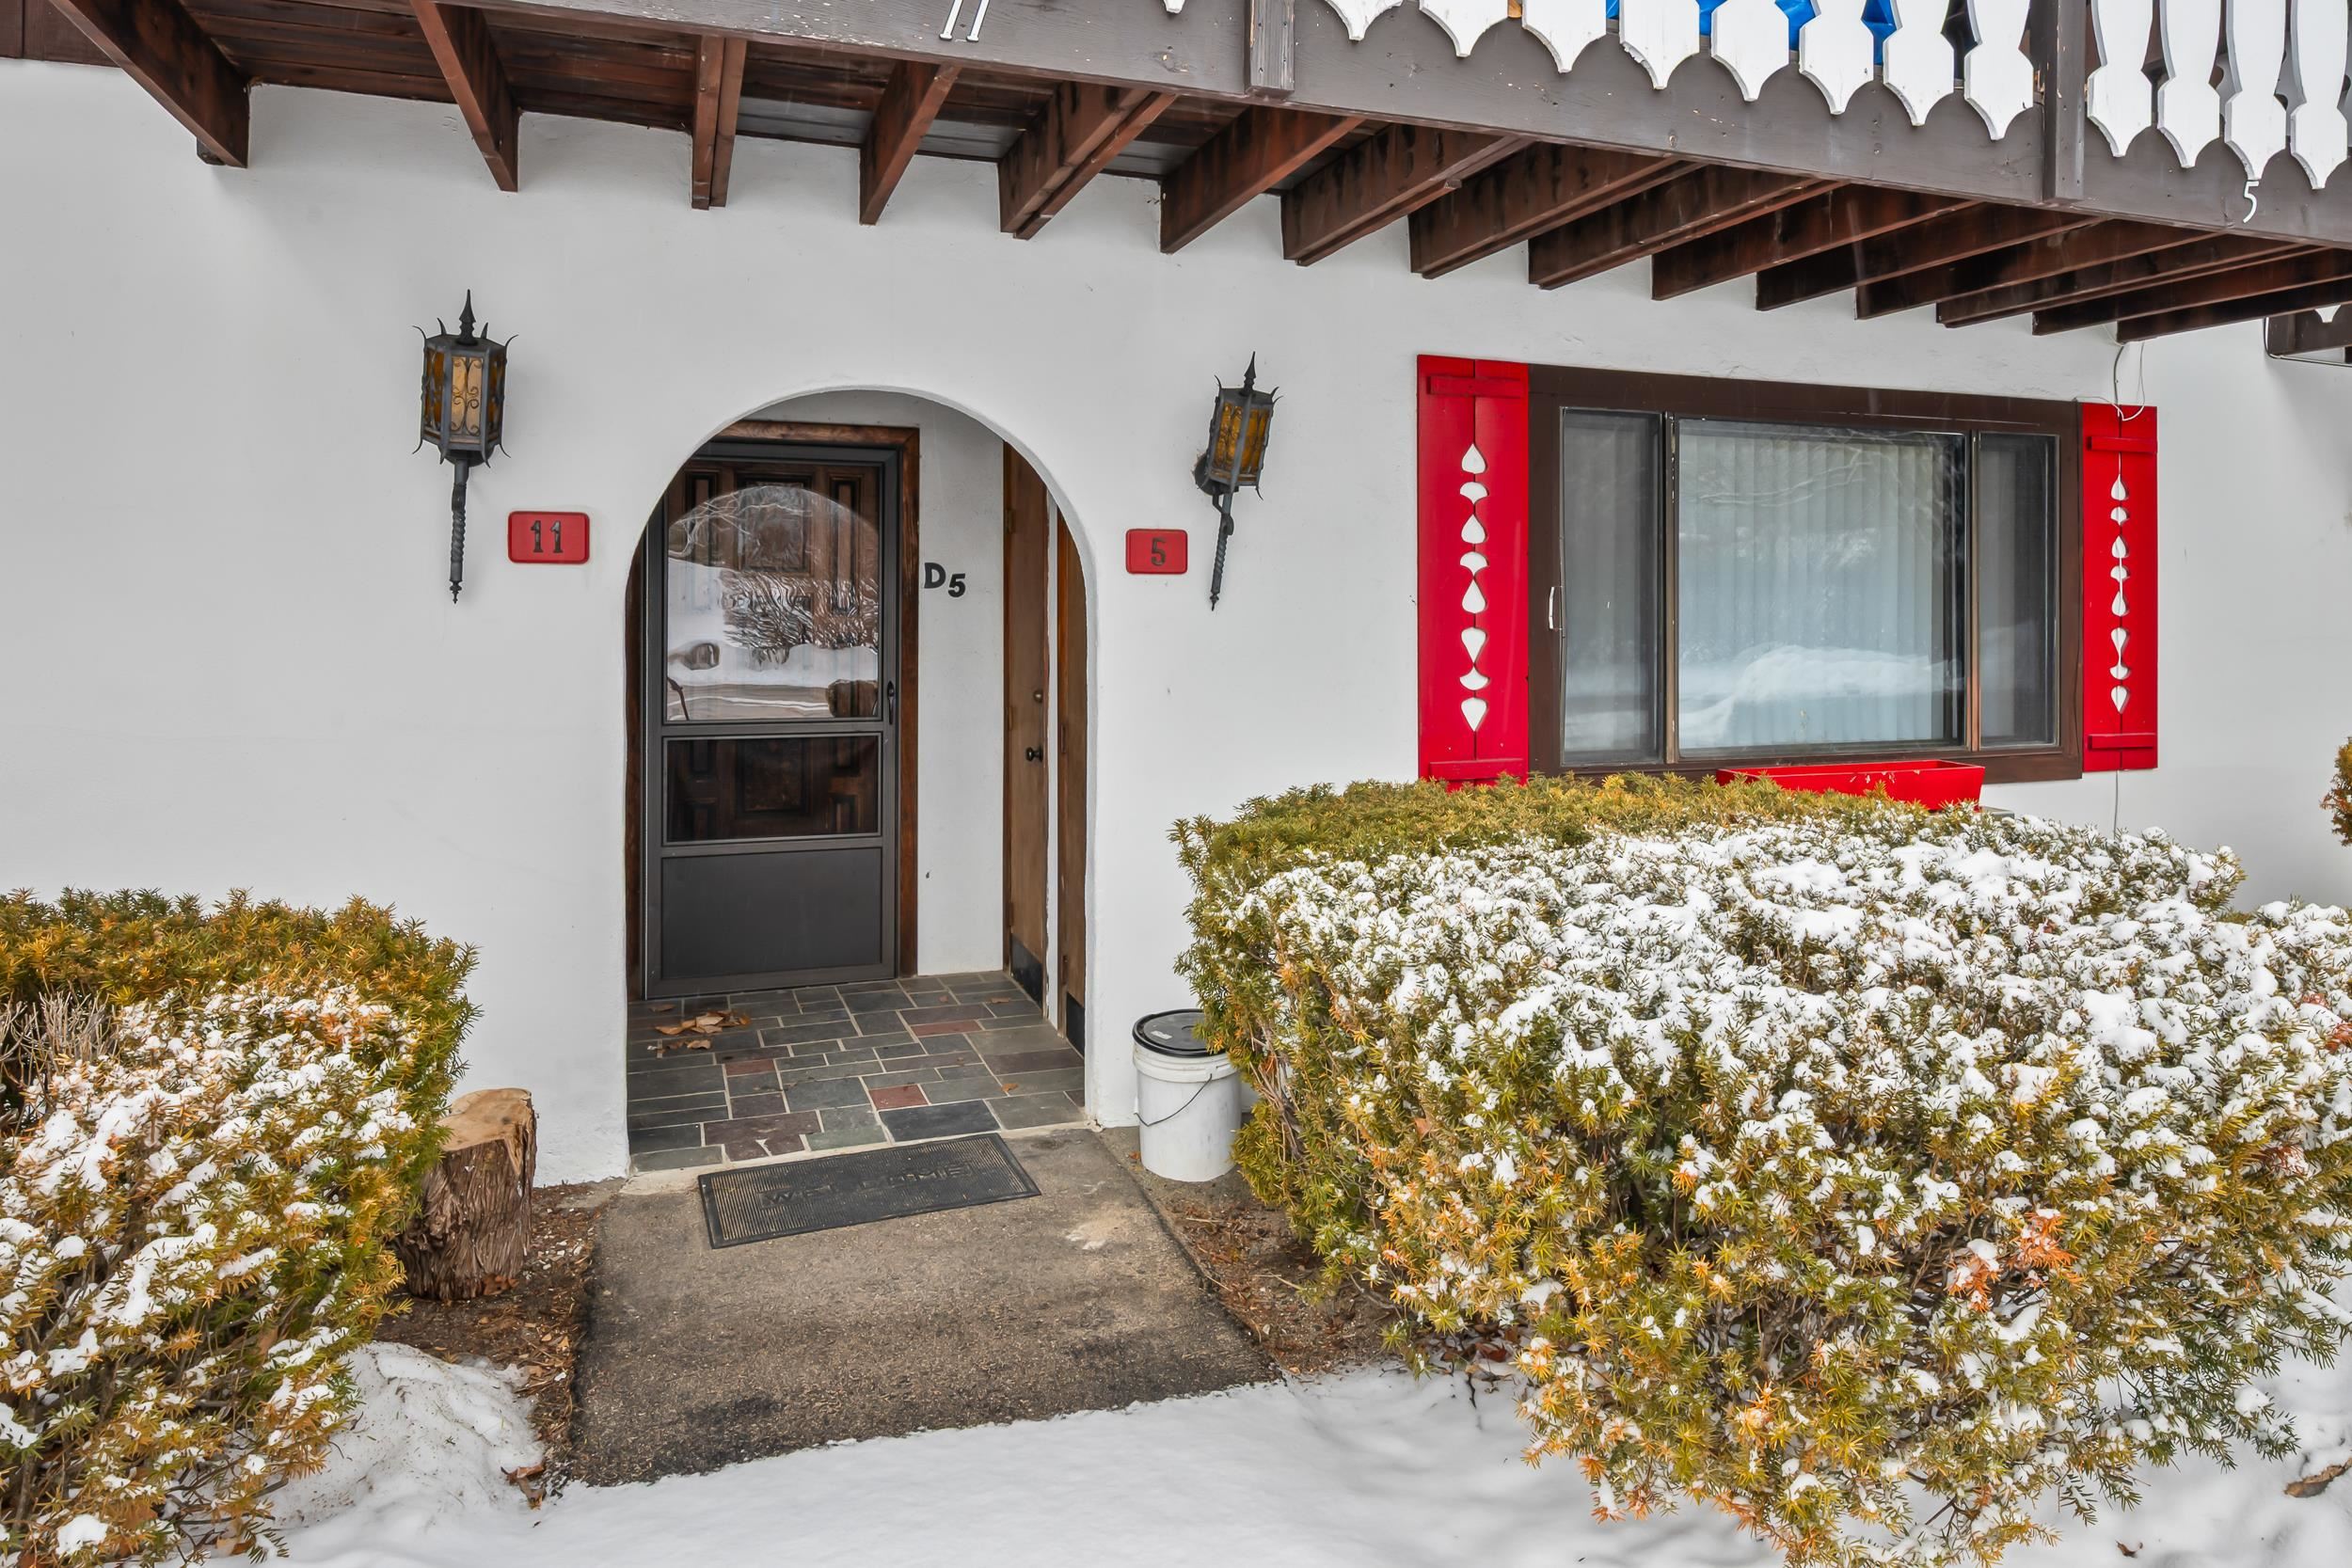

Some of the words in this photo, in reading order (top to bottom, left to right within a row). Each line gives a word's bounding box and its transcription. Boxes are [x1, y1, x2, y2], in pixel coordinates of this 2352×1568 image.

[2243, 181, 2260, 224] 5
[531, 519, 564, 553] 11
[1151, 537, 1167, 567] 5
